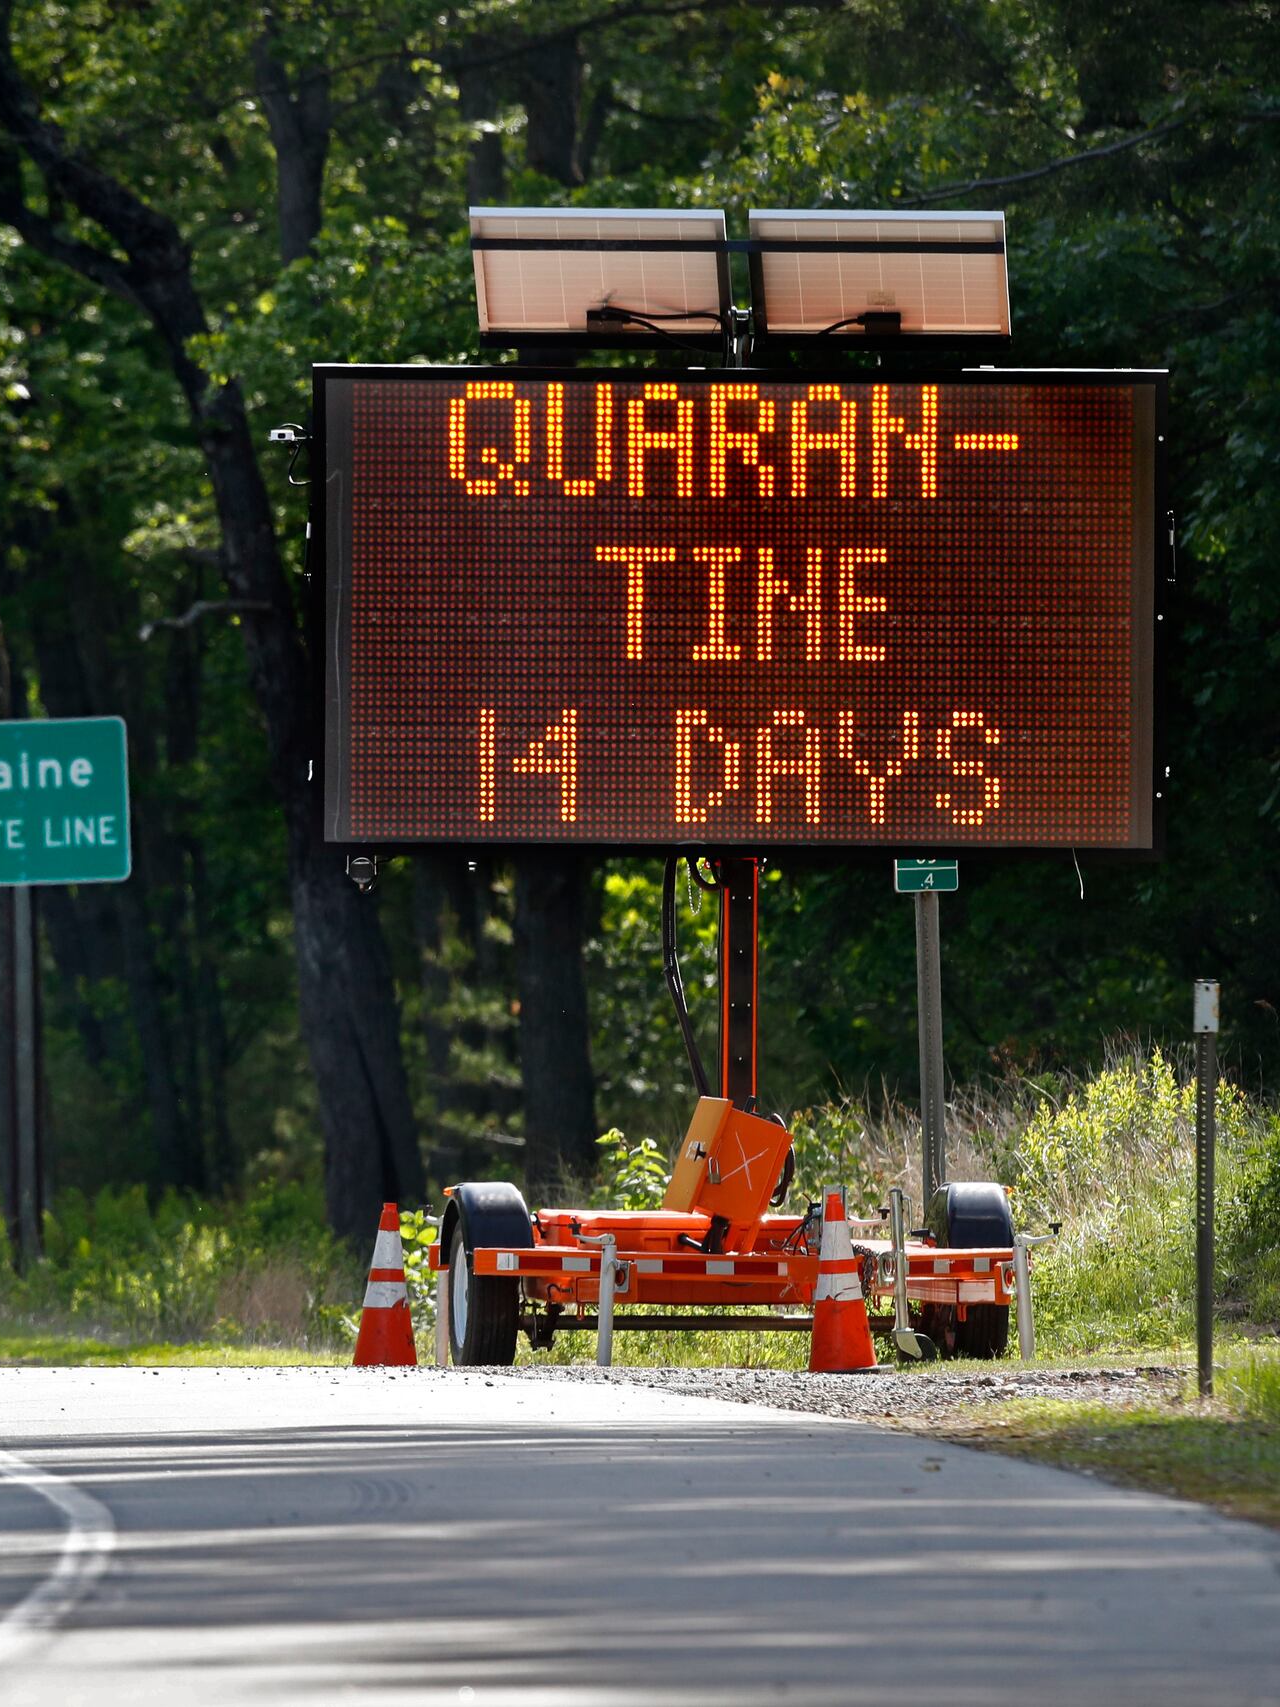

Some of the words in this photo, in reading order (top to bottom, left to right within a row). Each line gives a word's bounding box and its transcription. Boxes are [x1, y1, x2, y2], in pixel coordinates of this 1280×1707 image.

[449, 382, 1019, 497] QUARAN-
[596, 546, 887, 661] TINE
[478, 708, 577, 822] 14
[675, 709, 1001, 825] DAYS
[44, 815, 117, 848] LINE
